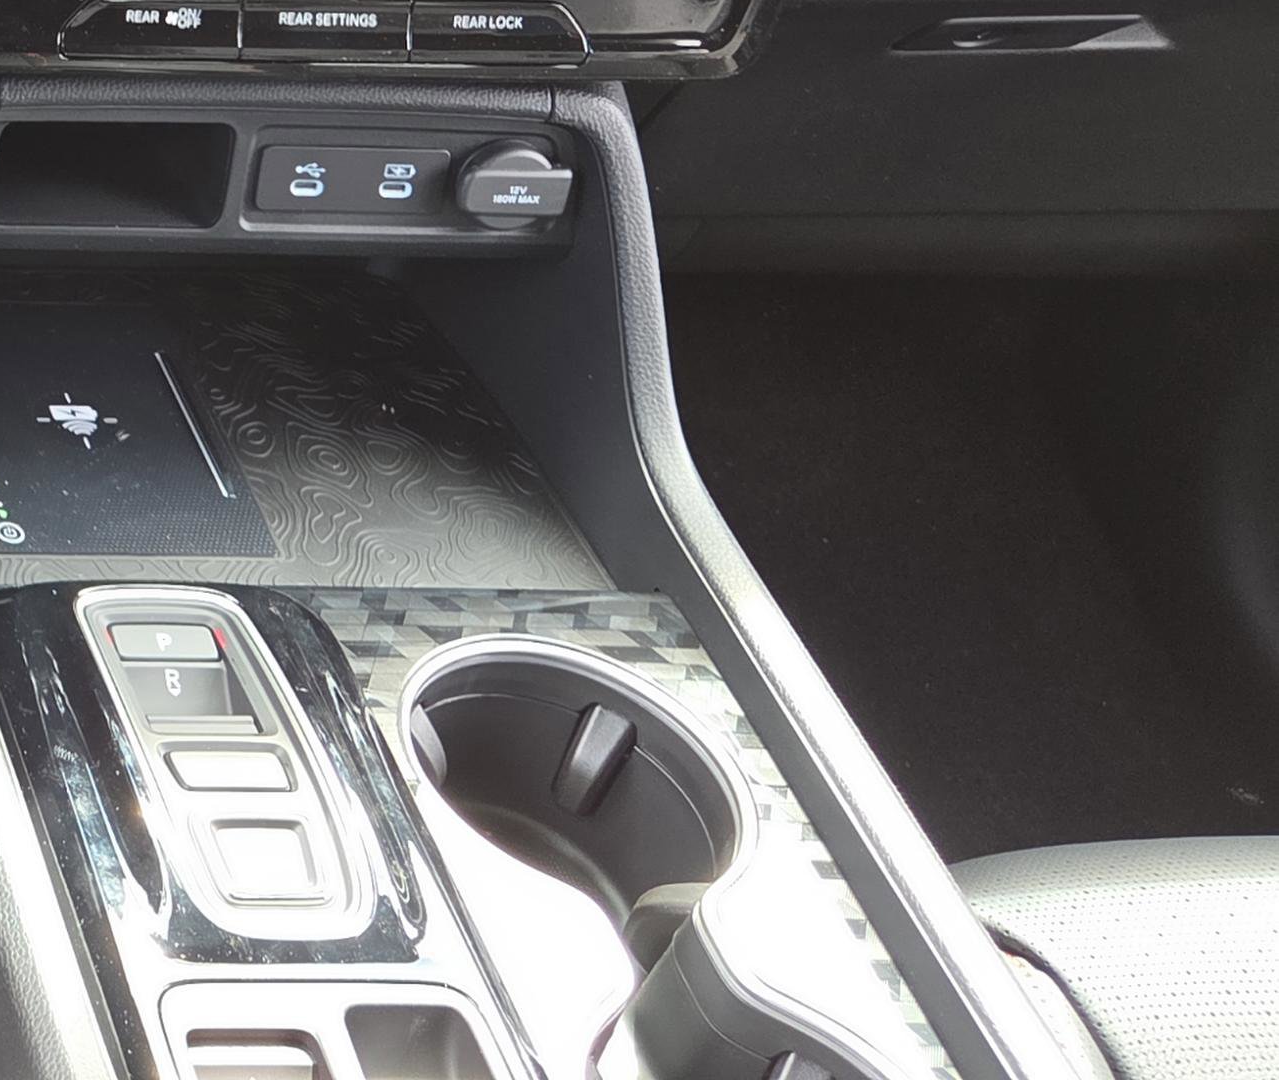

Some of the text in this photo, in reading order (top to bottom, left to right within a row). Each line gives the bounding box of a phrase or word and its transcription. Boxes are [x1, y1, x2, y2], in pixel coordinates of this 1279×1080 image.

[126, 9, 159, 24] REAR
[279, 12, 377, 28] REAR SETTINGS
[453, 15, 523, 30] REAR LOCK
[156, 632, 172, 652] P
